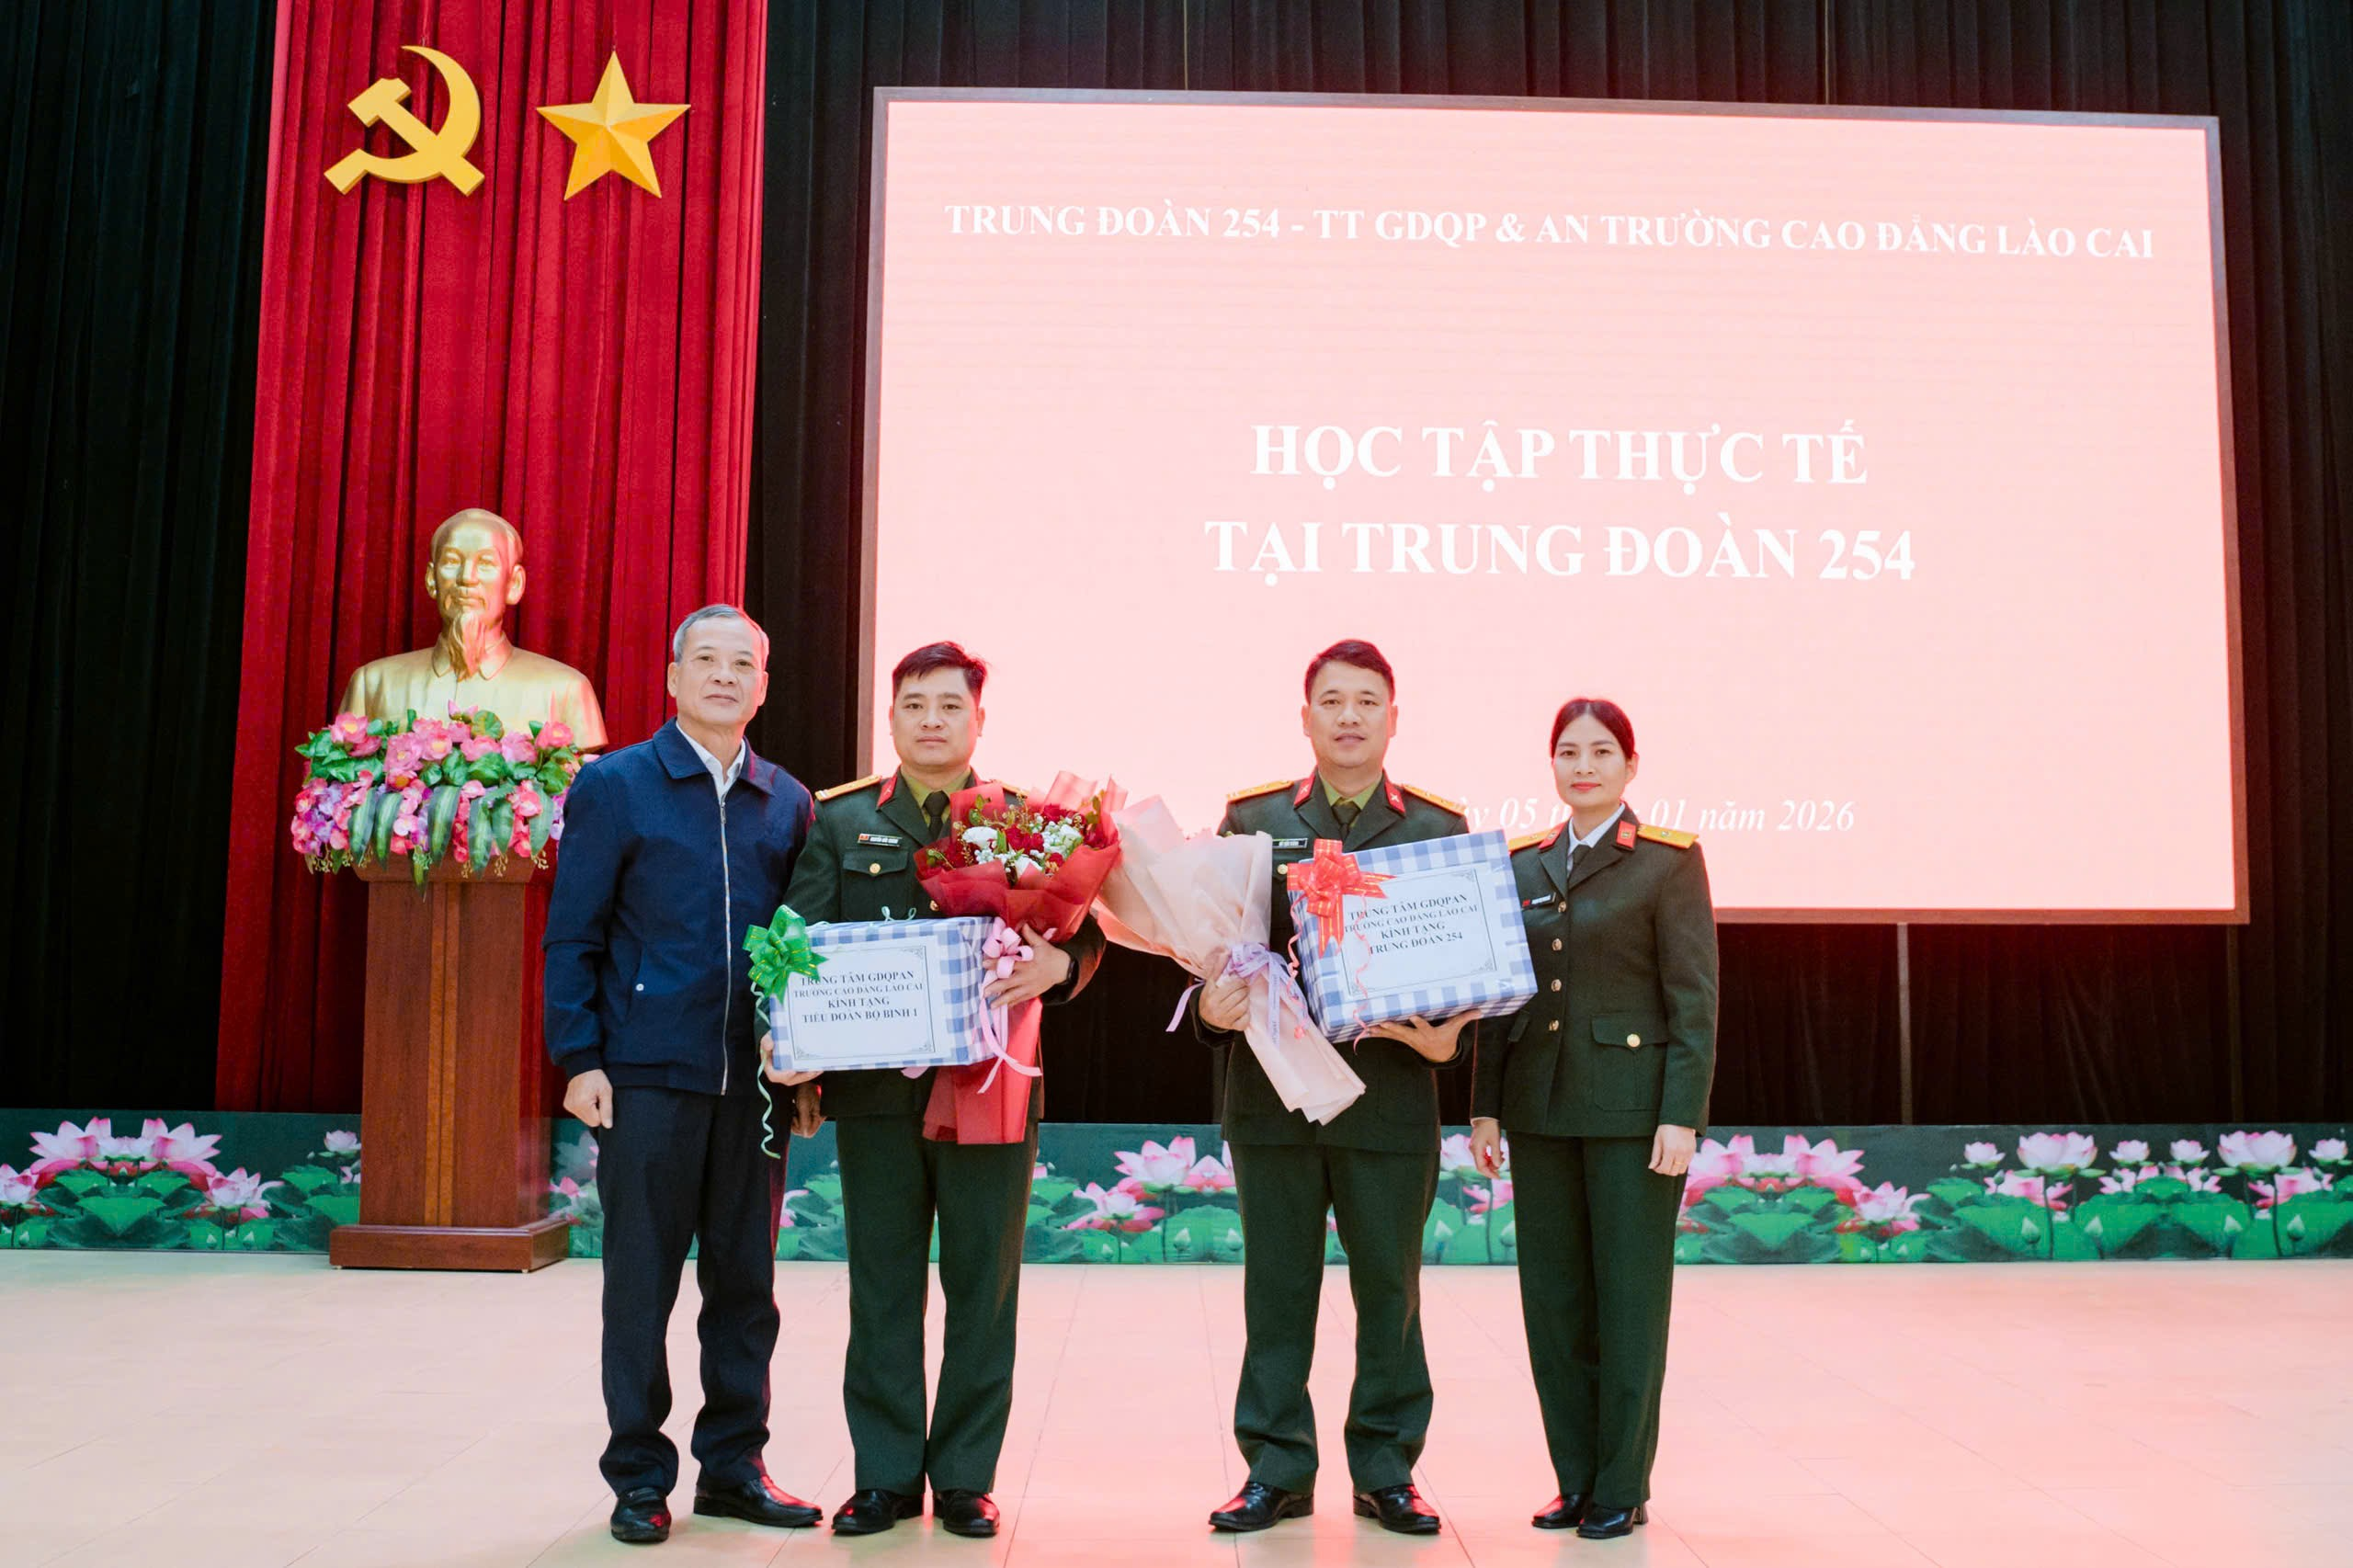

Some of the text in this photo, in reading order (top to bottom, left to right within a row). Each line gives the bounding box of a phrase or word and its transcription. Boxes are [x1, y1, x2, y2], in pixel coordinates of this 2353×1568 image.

[944, 205, 1086, 236] TRUNG
[1097, 199, 1211, 237] ĐOÀN
[1223, 209, 1279, 238] 254
[1313, 210, 1365, 240] TT
[1375, 211, 1487, 247] GDQP
[1495, 213, 1526, 244] &
[1535, 215, 1589, 244] AN
[1600, 210, 1770, 248] TRƯỜNG
[1781, 220, 1866, 251] CAO
[1997, 219, 2076, 256] LÀO
[2086, 227, 2154, 258] CAI
[1249, 419, 1868, 496] HỌC TẬP THỰC TẾ
[1204, 512, 1915, 587] TẠI TRUNG ĐOÀN 254
[1499, 798, 1538, 829] 05
[1650, 799, 1686, 830] 01
[1699, 801, 1766, 832] năm
[1777, 799, 1855, 832] 2026
[1369, 939, 1409, 955] TRUNG
[1446, 931, 1463, 942] 254
[840, 971, 866, 984] TÂM
[868, 971, 915, 983] GDQPAN
